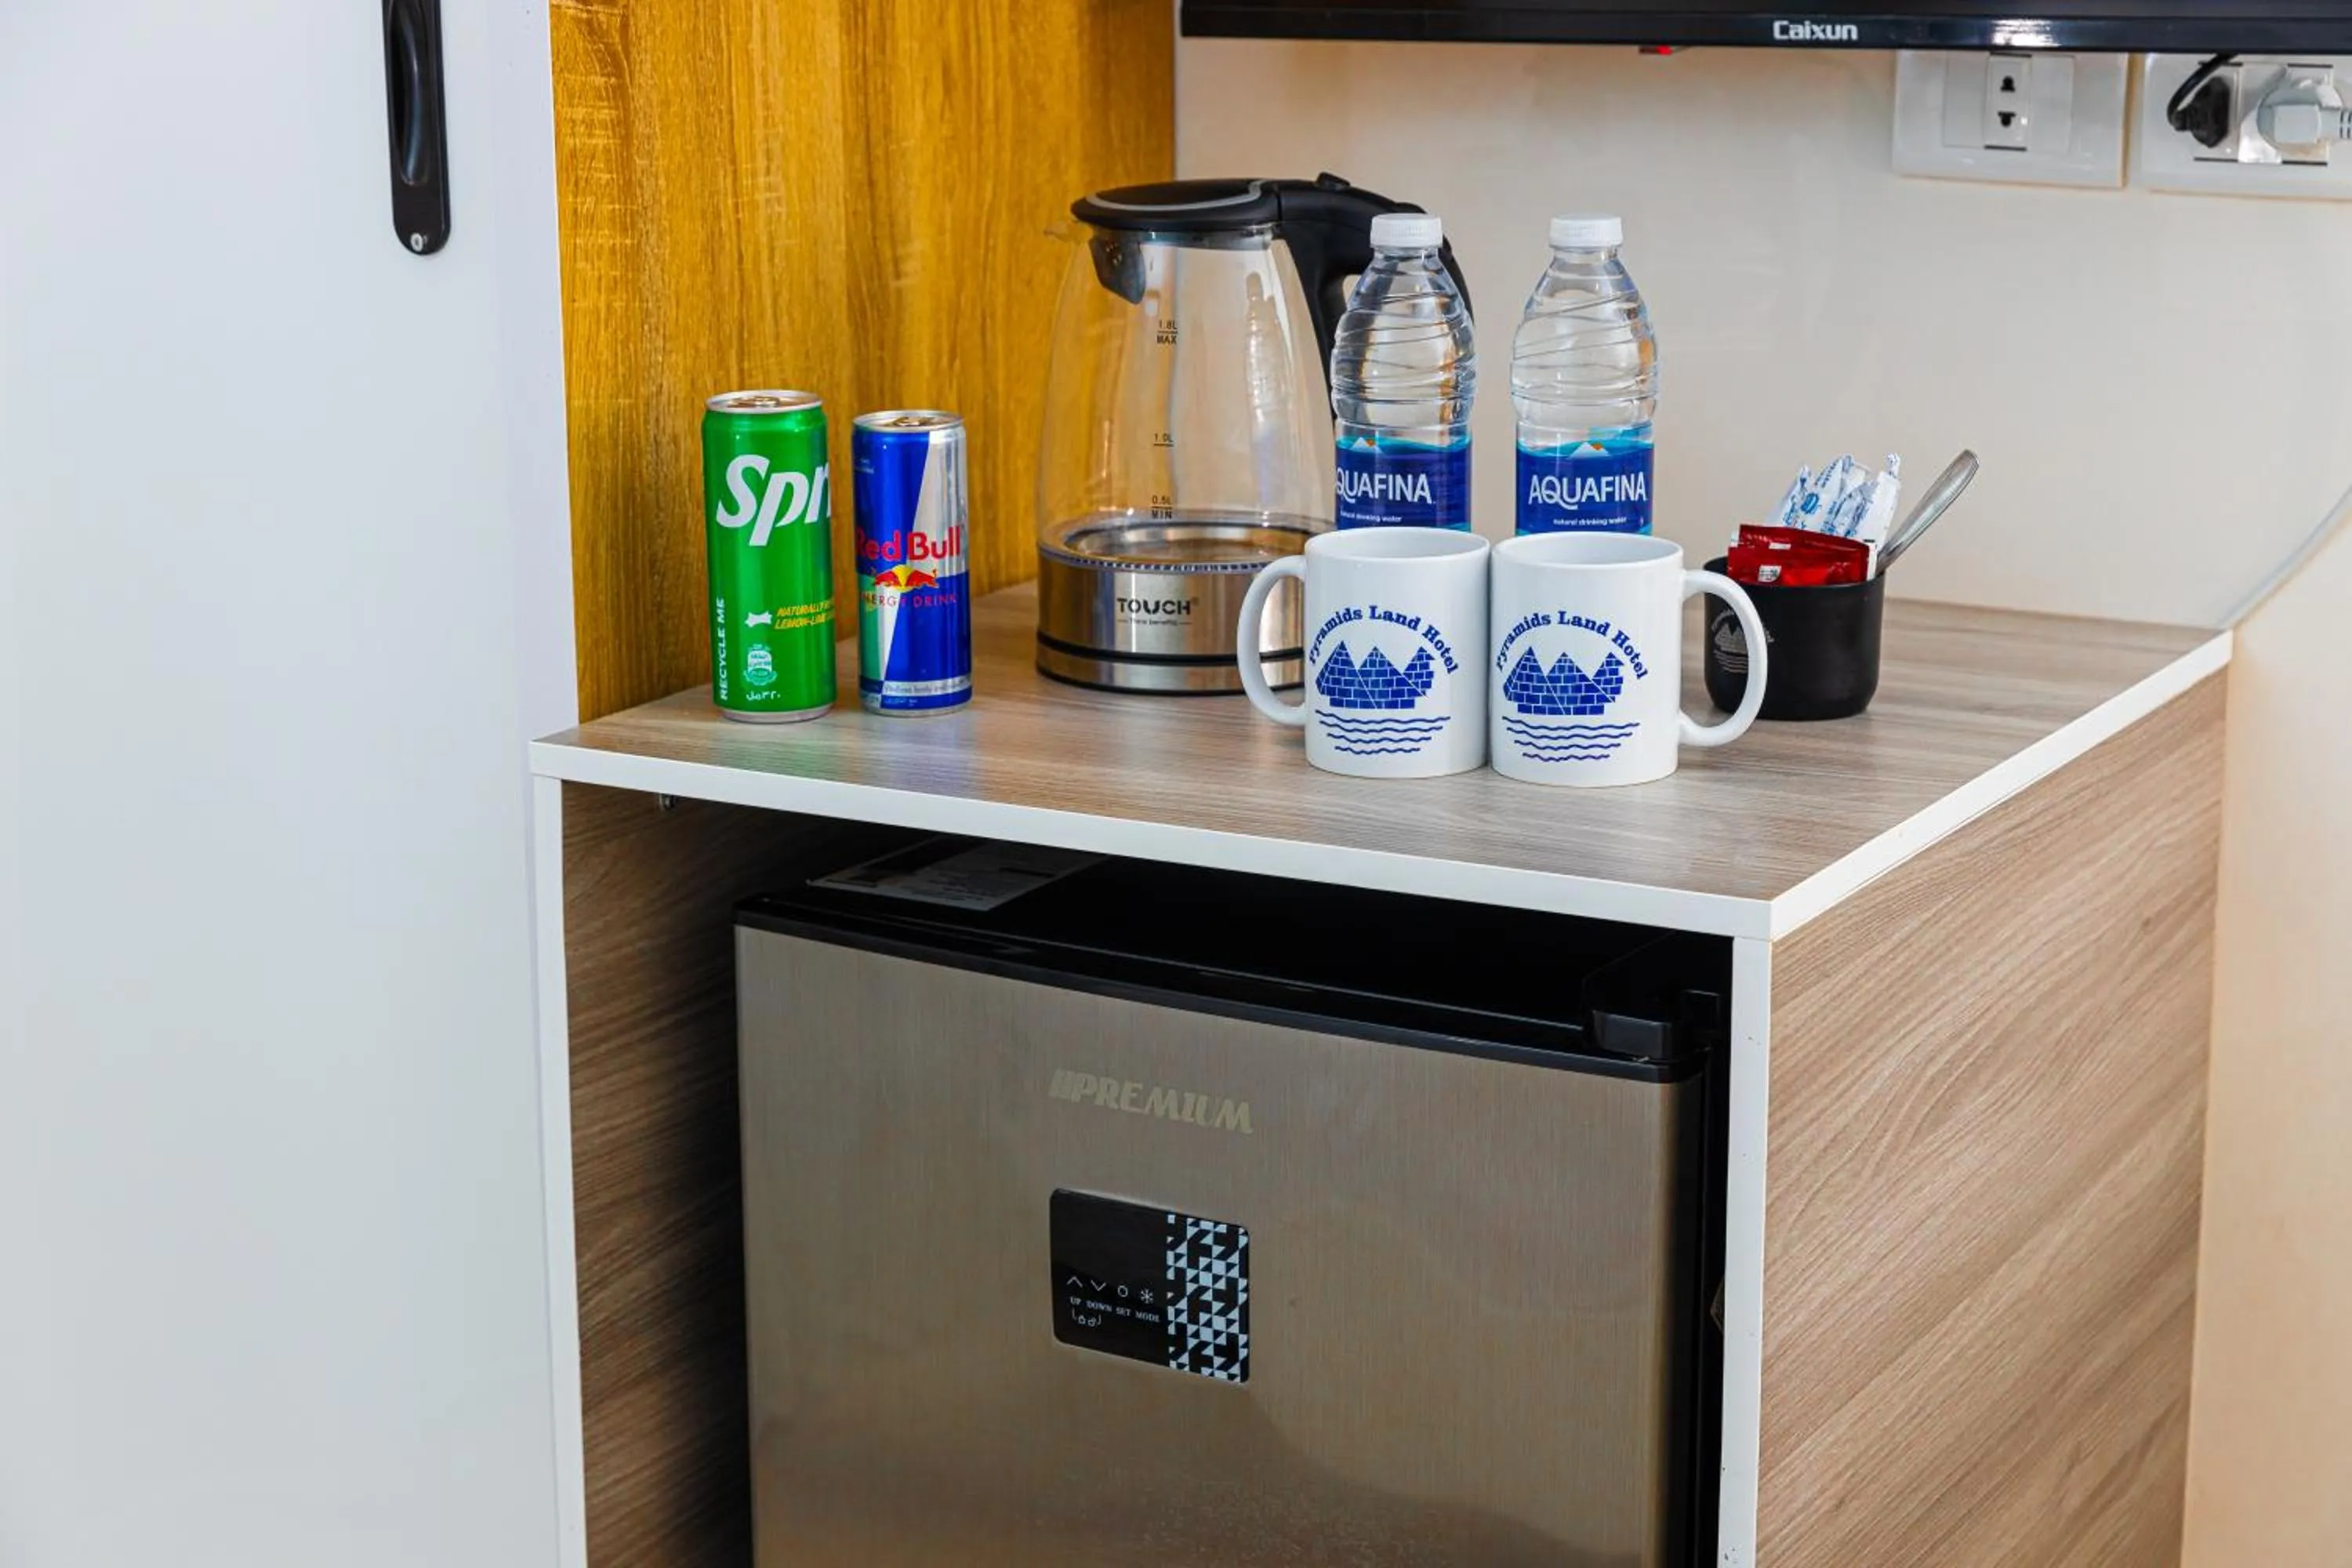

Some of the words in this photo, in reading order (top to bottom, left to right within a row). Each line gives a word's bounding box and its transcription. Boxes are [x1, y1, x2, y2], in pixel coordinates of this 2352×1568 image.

[1773, 20, 1858, 40] Caixun
[1156, 335, 1177, 344] MAX
[1337, 466, 1432, 504] QUAFINA
[1528, 471, 1646, 510] AQUAFINA
[907, 526, 961, 561] Bull
[716, 597, 726, 624] ME
[1116, 597, 1191, 615] TOUCH
[1368, 604, 1421, 631] Land
[1421, 624, 1459, 674] Hotel
[1557, 610, 1611, 637] Land
[1611, 630, 1649, 680] Hotel
[717, 626, 728, 700] RECYCLE
[1068, 1072, 1254, 1134] PREMIUM
